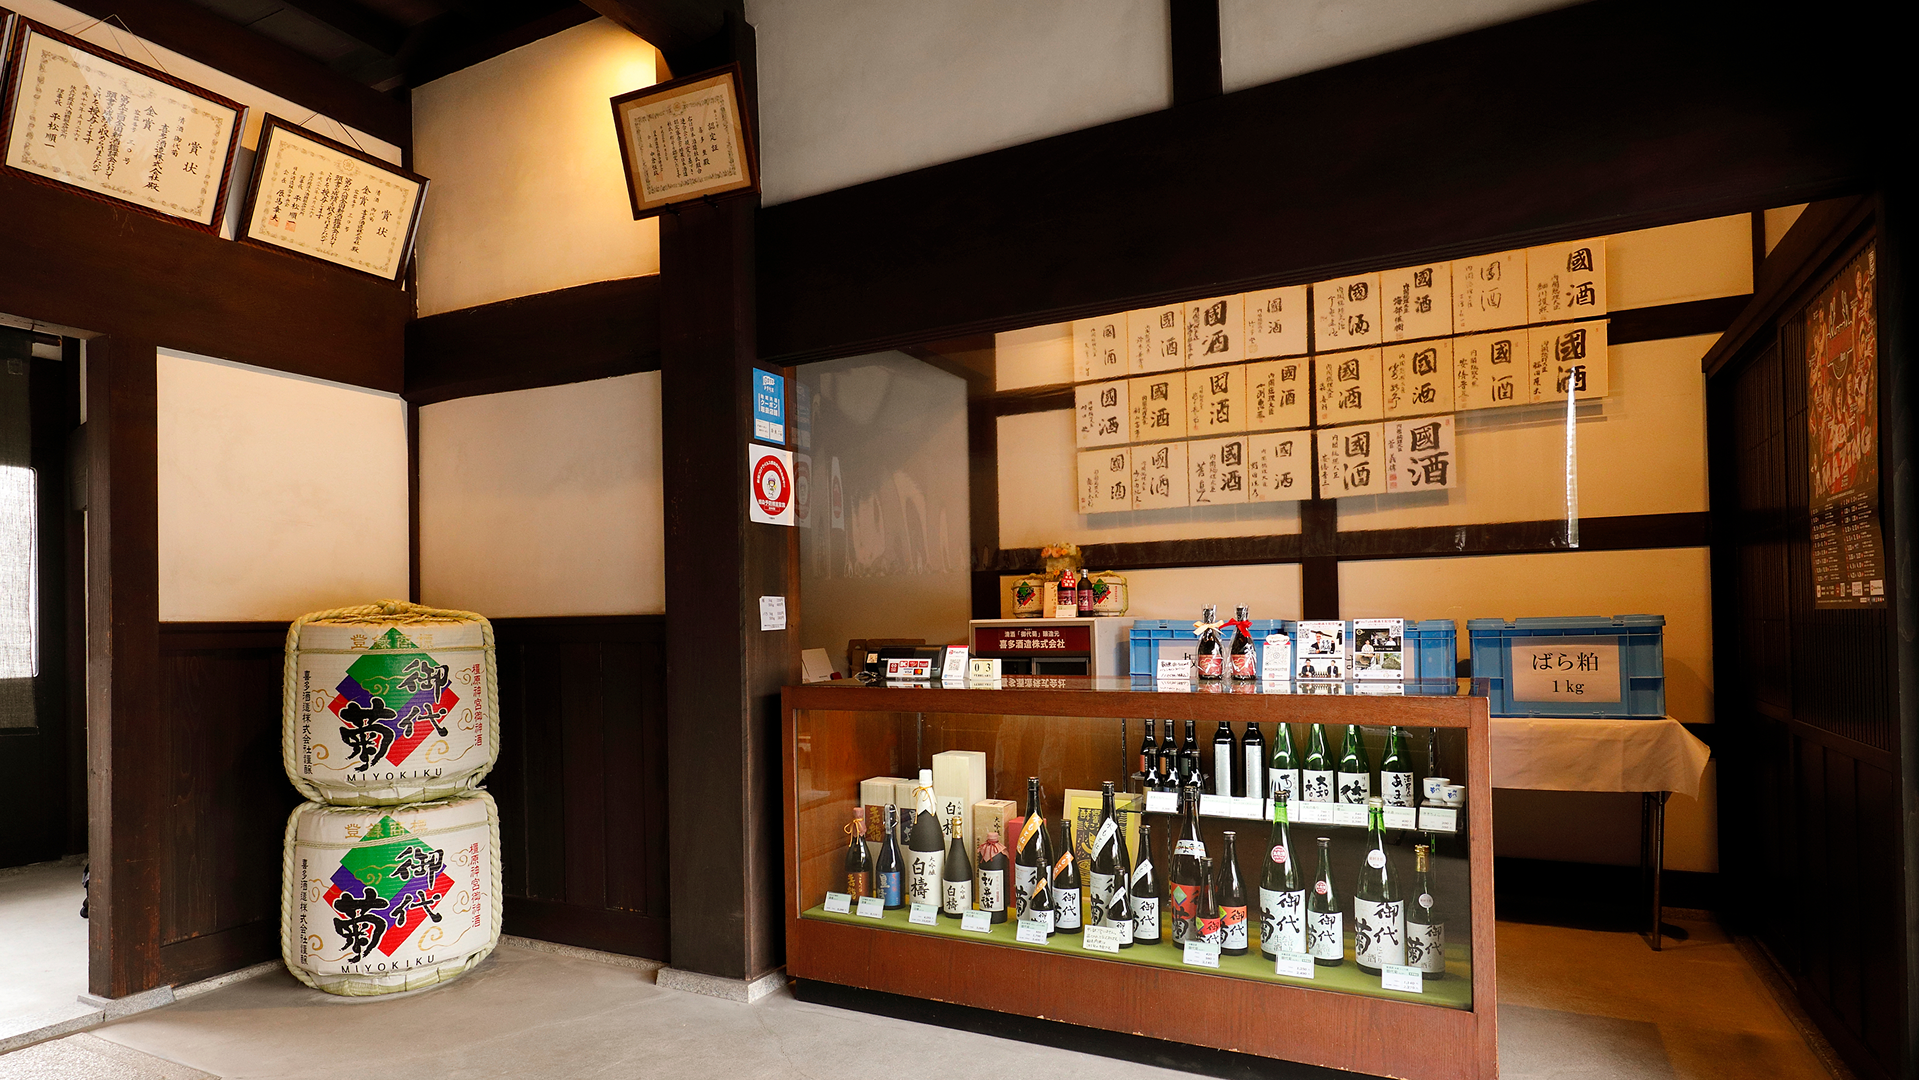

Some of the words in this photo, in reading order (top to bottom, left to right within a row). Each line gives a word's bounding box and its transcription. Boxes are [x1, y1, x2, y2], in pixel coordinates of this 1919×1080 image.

[142, 105, 158, 131] 金賞
[182, 141, 202, 176] 賞状
[359, 185, 371, 207] 金賞
[375, 209, 393, 238] 賞状
[1413, 266, 1433, 314] 國酒
[1566, 247, 1596, 308] 國酒
[1160, 310, 1178, 358] 國酒
[1201, 300, 1230, 357] 國酒
[1279, 365, 1298, 408] 國酒
[1337, 358, 1363, 411] 國酒
[1412, 347, 1437, 405] 國酒
[1490, 339, 1514, 402] 國酒
[760, 399, 778, 409] クーポン
[1149, 381, 1170, 428] 國酒
[1219, 440, 1242, 492] 國酒
[1274, 439, 1294, 490] 國酒
[1343, 430, 1371, 490] 國酒
[1406, 421, 1449, 487] 國酒
[1109, 453, 1127, 501] 國酒
[999, 639, 1065, 649] 喜多酒造株式会社
[1532, 652, 1599, 671] ばら粕
[1566, 680, 1584, 695] kg
[347, 768, 442, 781] MIYOKIKU
[1276, 892, 1301, 934] 御代
[1374, 902, 1400, 946] 御代
[341, 955, 436, 973] MIYOKIKU
